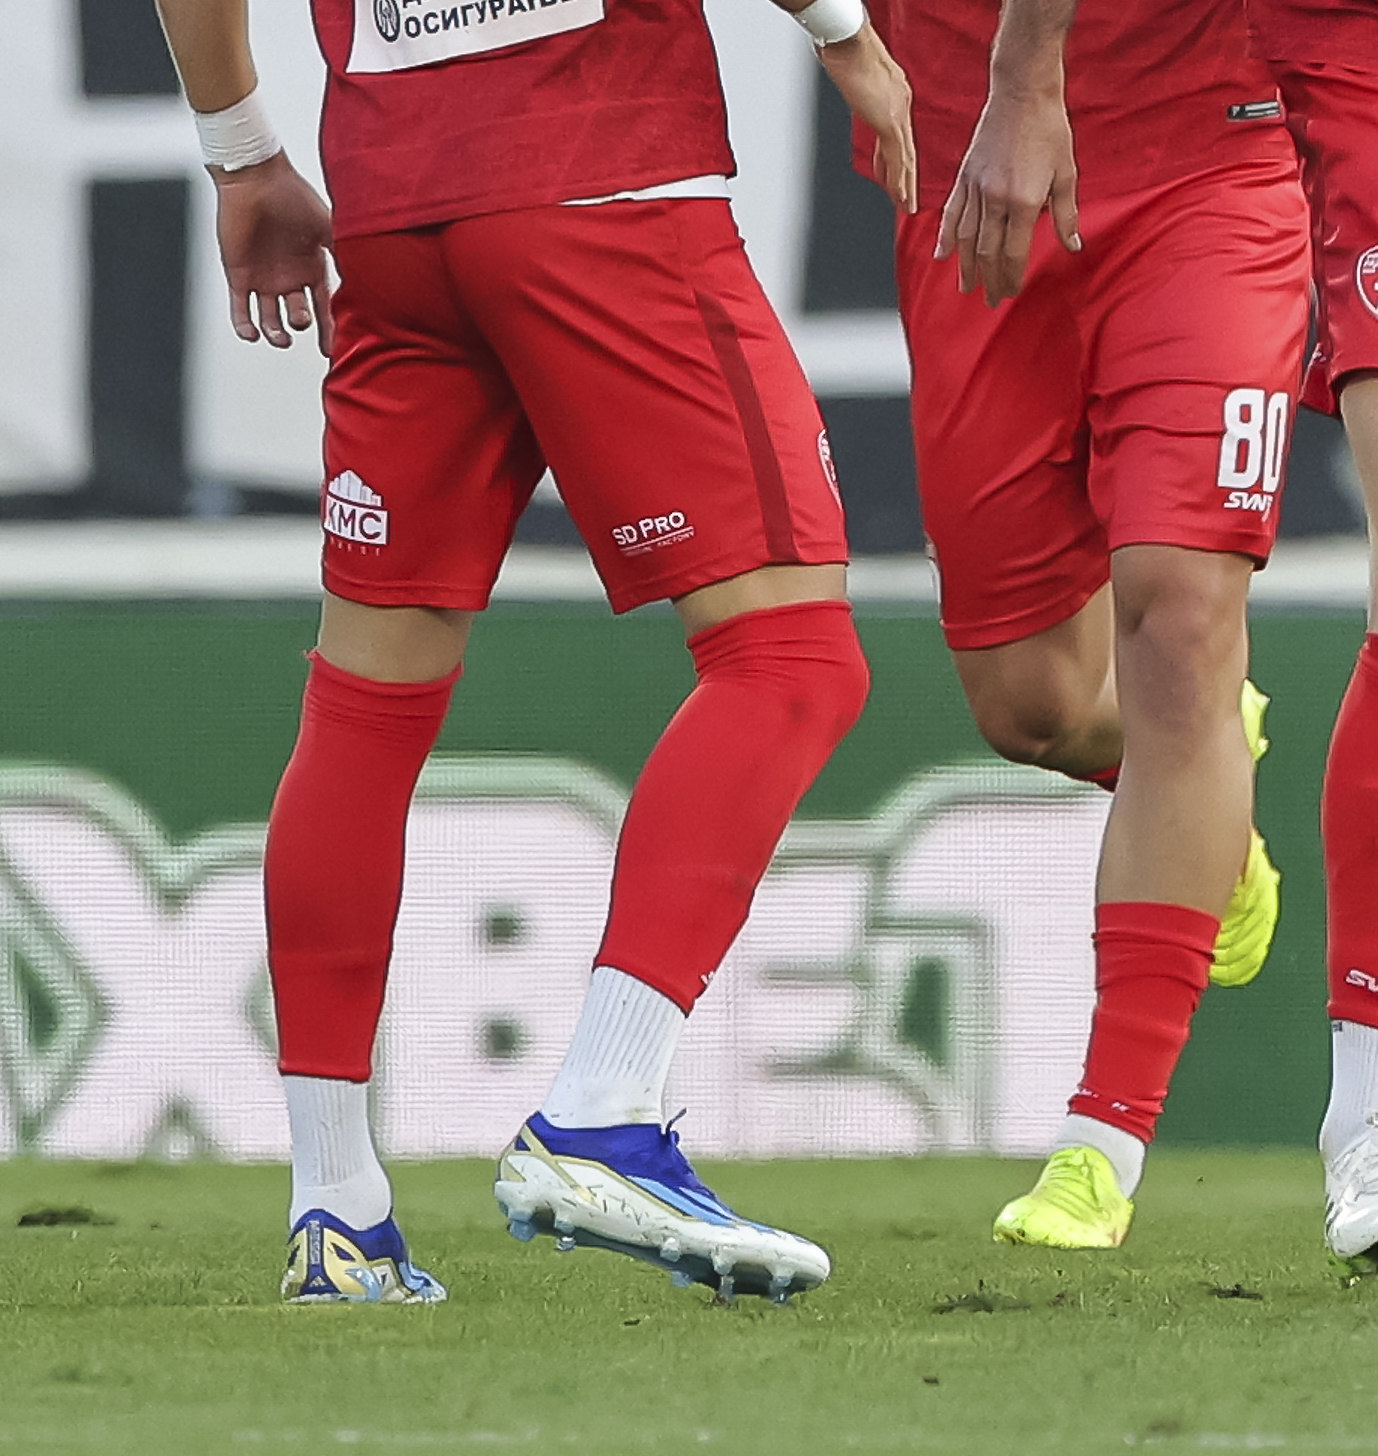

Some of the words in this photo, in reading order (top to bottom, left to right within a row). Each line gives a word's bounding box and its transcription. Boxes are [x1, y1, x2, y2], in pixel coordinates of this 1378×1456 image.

[1217, 387, 1290, 494] 80
[327, 501, 384, 542] KMC
[612, 525, 638, 547] SD
[639, 510, 687, 539] PRO
